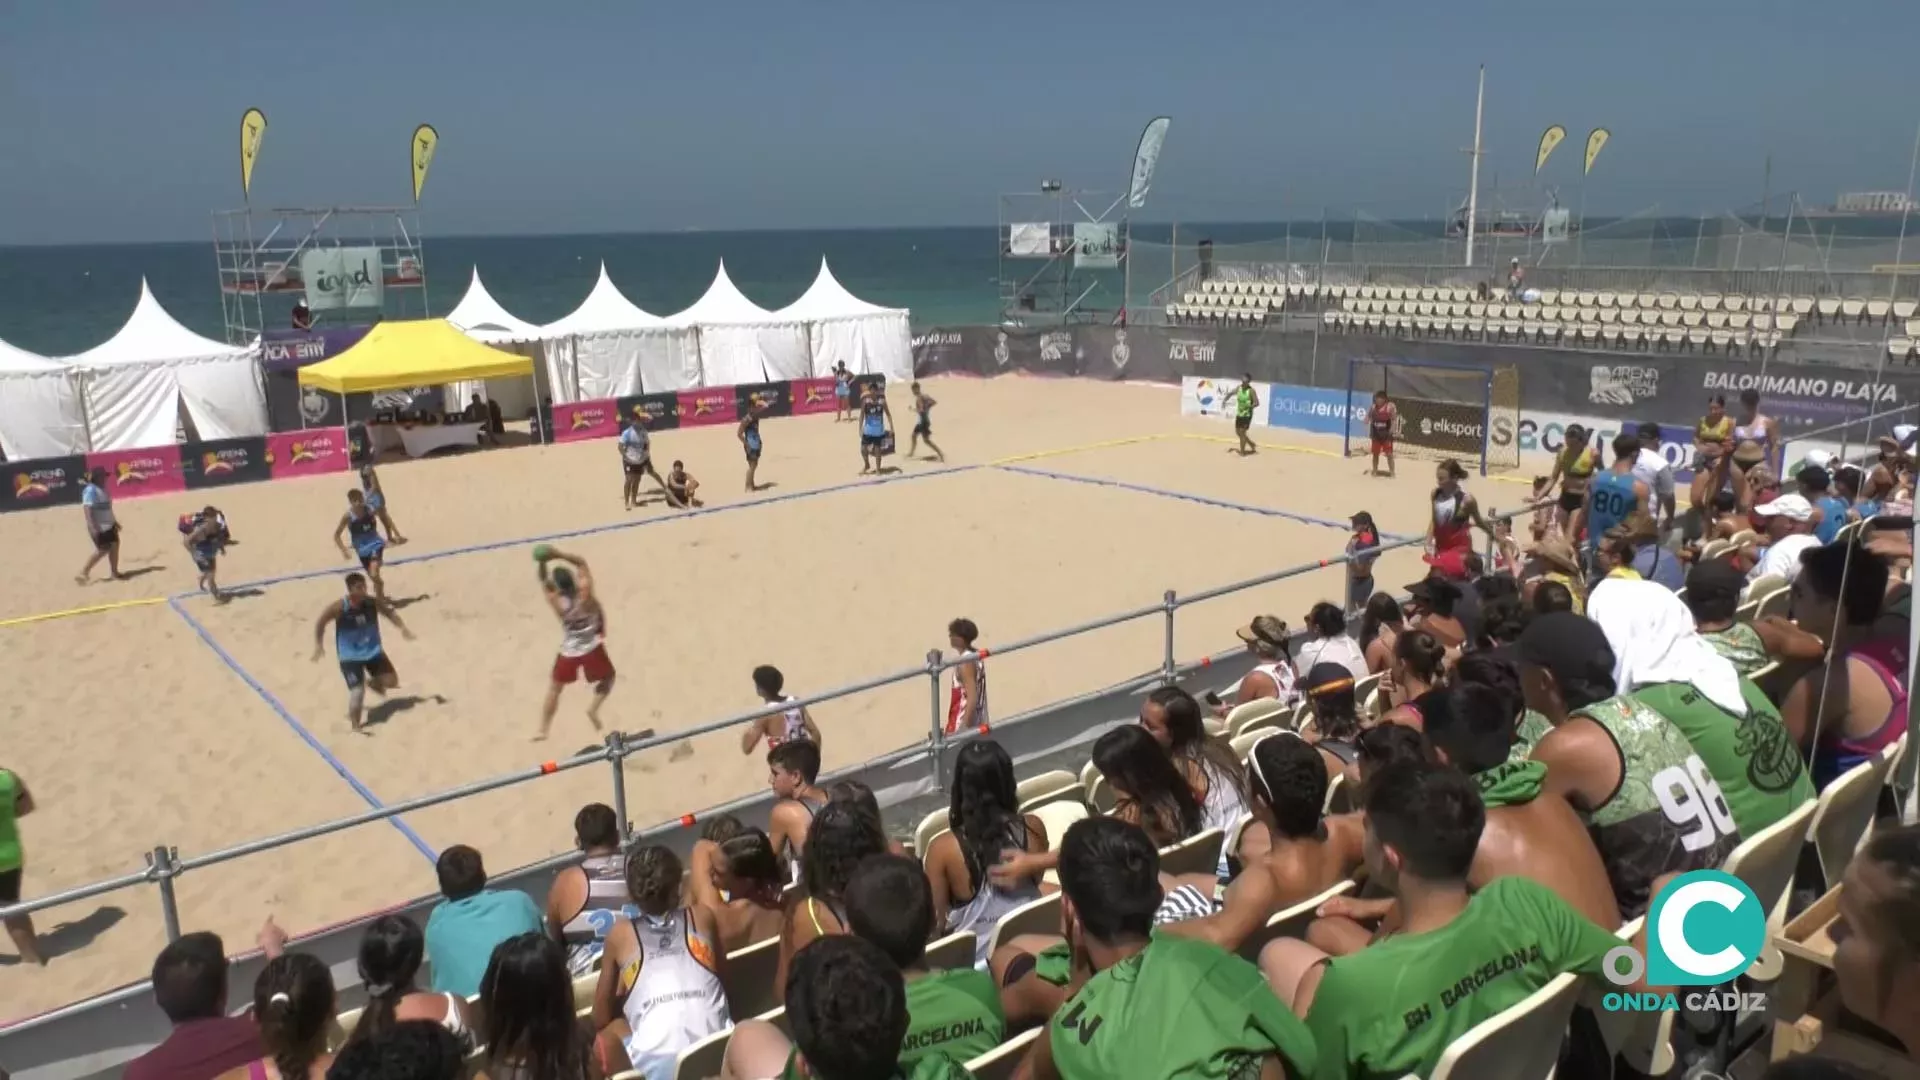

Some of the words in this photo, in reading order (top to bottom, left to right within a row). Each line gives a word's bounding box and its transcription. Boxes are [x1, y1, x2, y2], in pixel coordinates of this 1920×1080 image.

[1703, 371, 1828, 397] BALONMANO
[1831, 380, 1898, 403] PLAYA
[1433, 418, 1483, 437] elksport
[1595, 489, 1624, 516] 80
[1652, 754, 1737, 852] 96
[901, 1016, 985, 1051] ARCELONA
